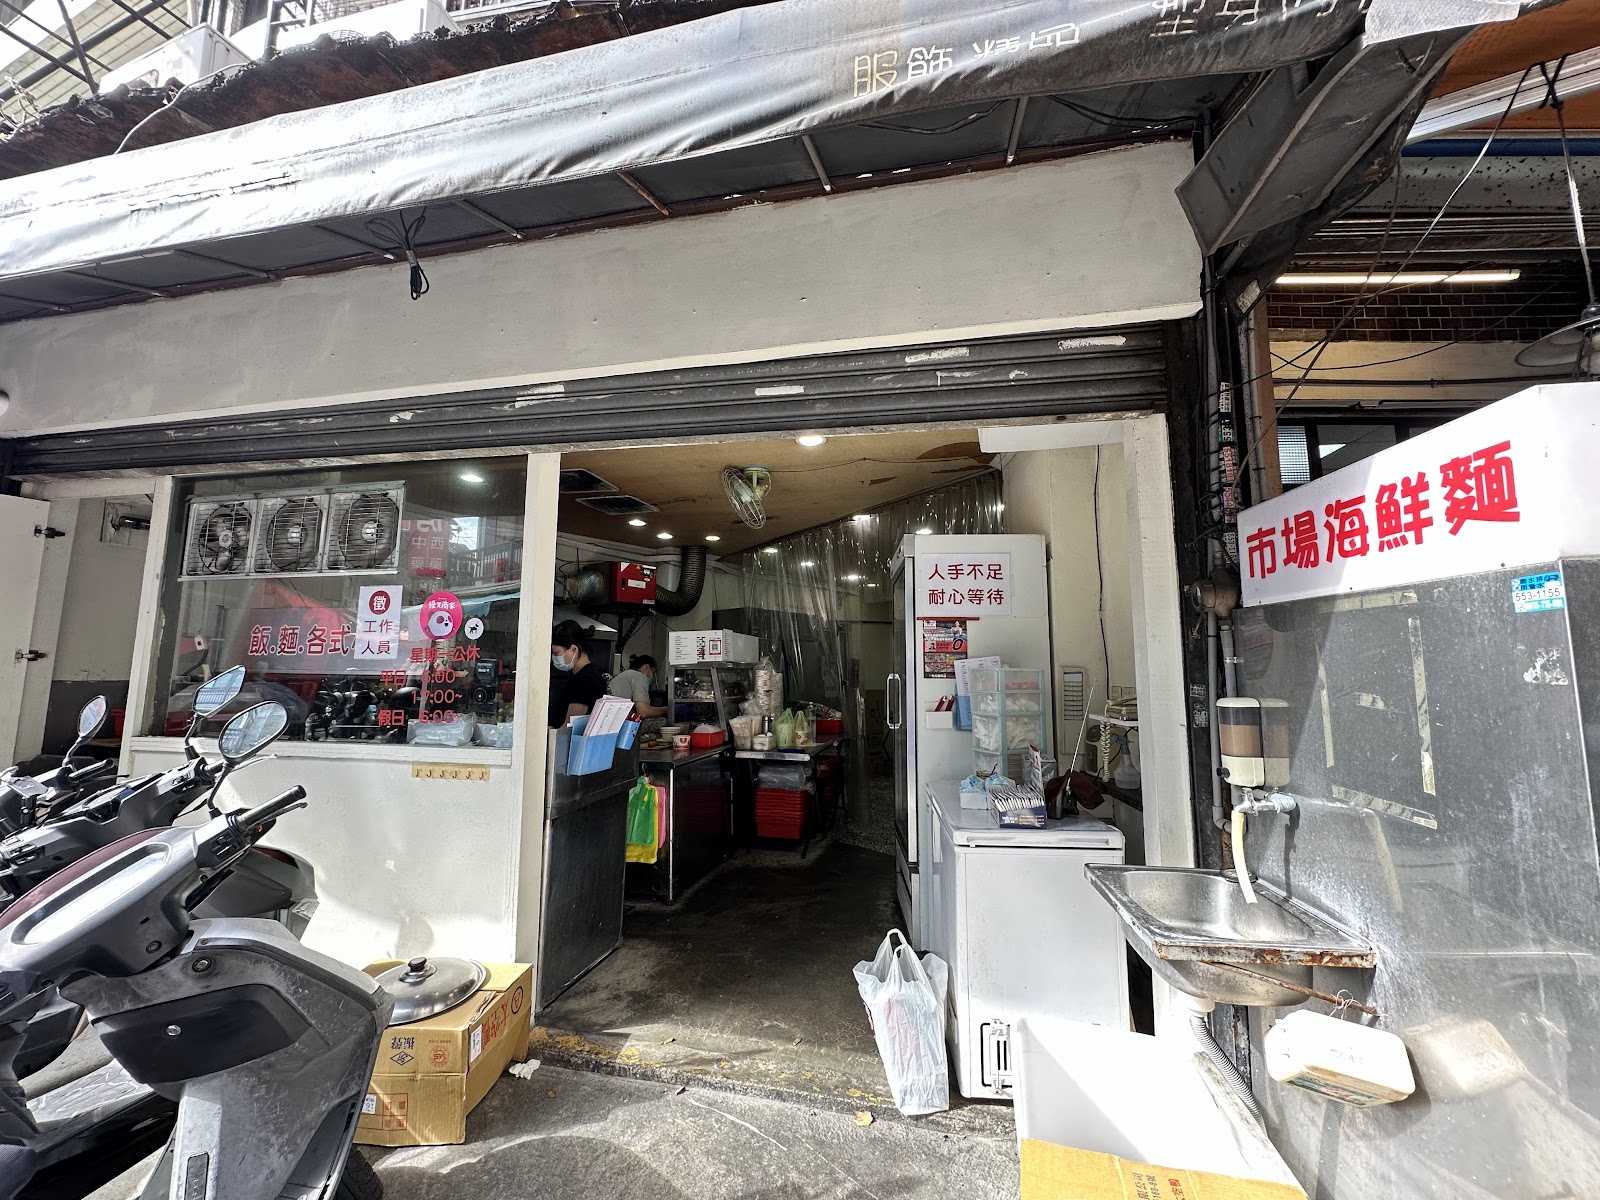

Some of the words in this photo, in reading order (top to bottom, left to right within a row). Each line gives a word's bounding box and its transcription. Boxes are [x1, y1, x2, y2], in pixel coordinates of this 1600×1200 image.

[1246, 440, 1520, 579] 市場海鮮麵
[928, 563, 1004, 581] 人手不足
[372, 595, 387, 611] 徵
[928, 588, 1005, 606] 耐心等待
[1515, 588, 1561, 601] 553-1155
[363, 619, 393, 634] 工作
[248, 624, 357, 656] 飯.麵.各式
[361, 640, 391, 655] 人員
[410, 645, 481, 663] 星期一公休
[379, 670, 407, 686] 平日
[377, 709, 405, 726] 假日
